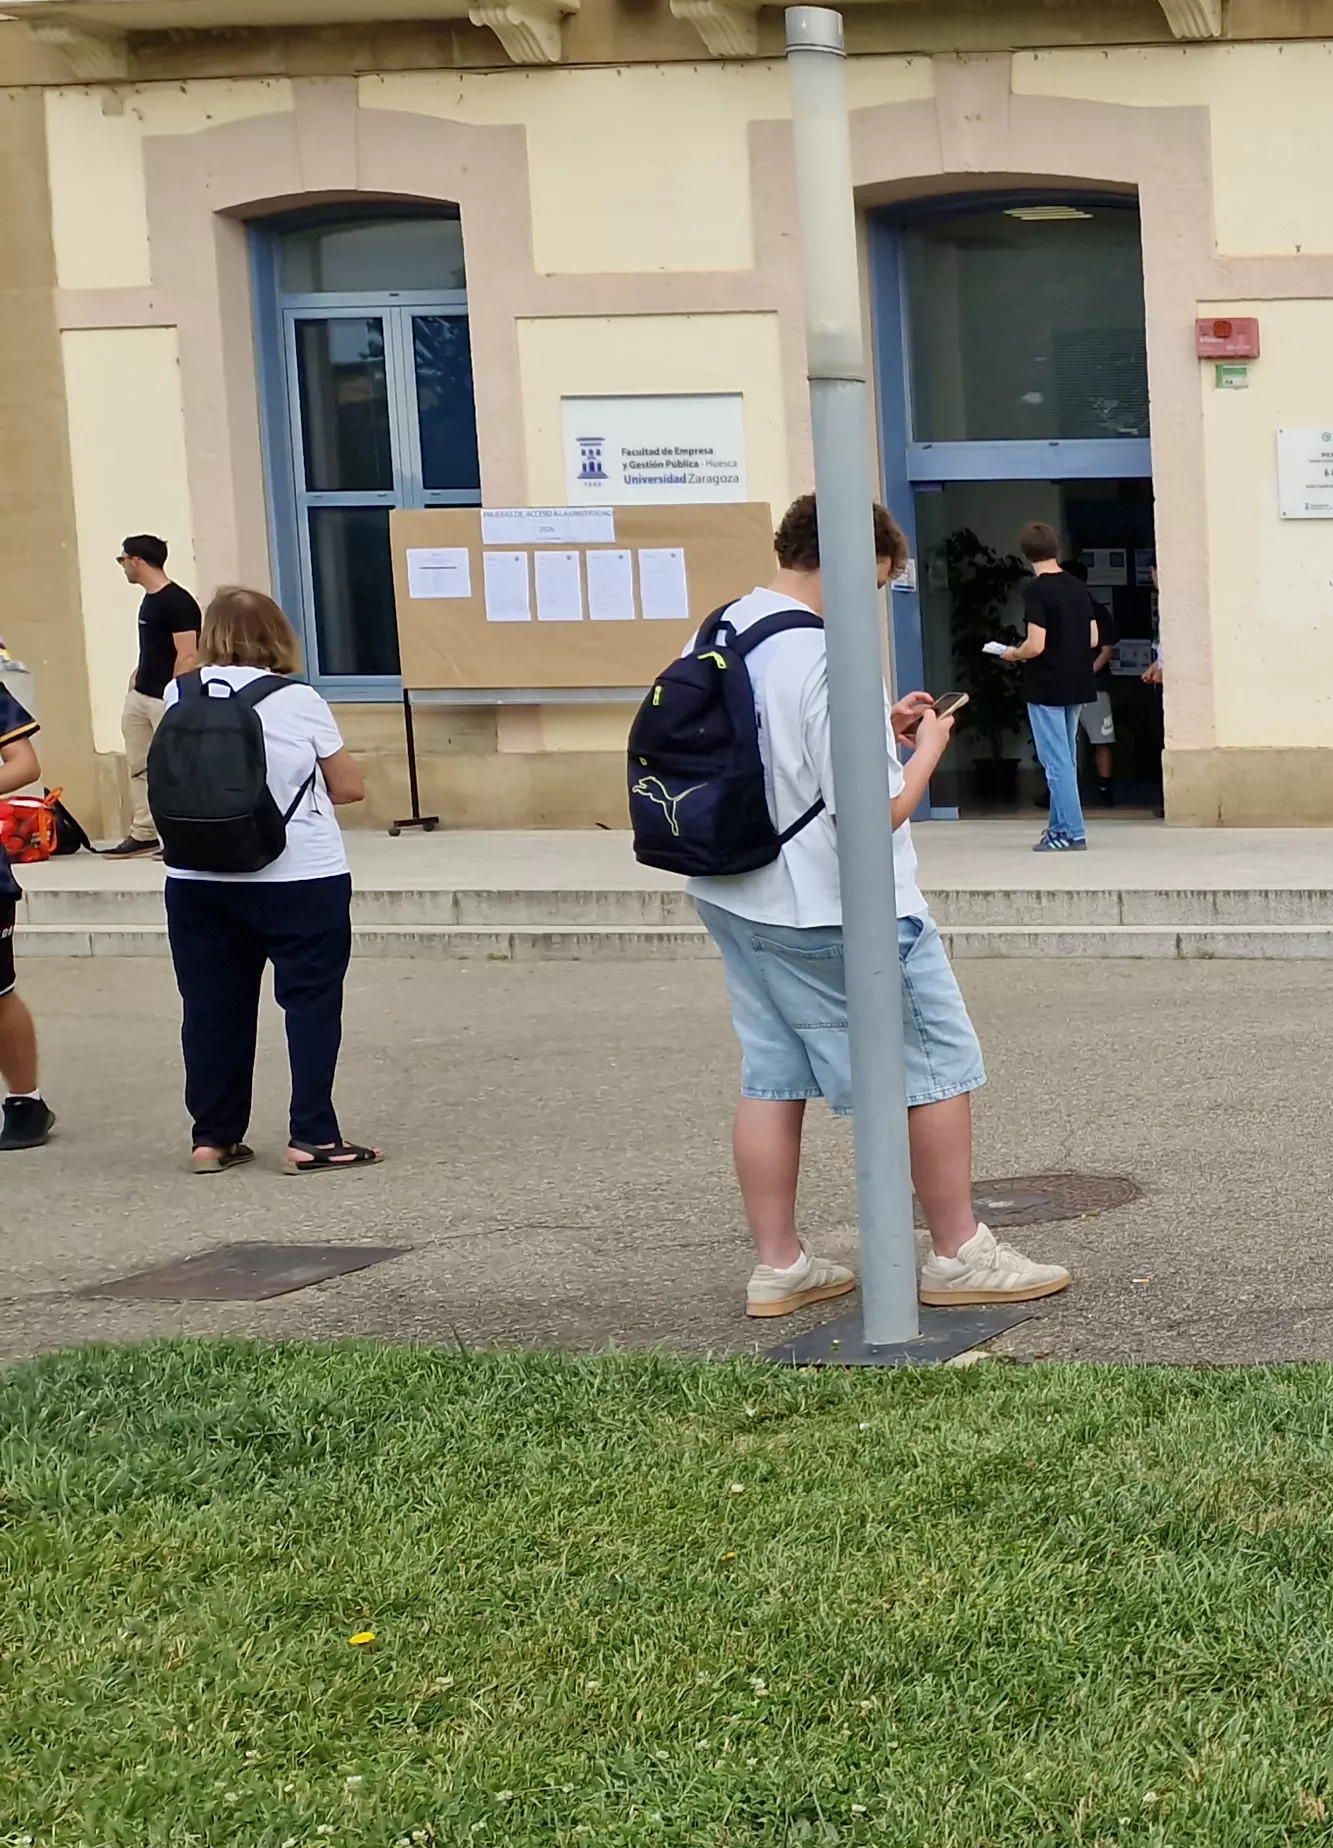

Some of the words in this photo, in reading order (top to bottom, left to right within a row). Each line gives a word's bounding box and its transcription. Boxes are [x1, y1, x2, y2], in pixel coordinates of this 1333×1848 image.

[621, 447, 661, 456] Facultad
[661, 447, 673, 456] de
[674, 446, 713, 457] Empresa
[622, 462, 628, 471] y
[629, 460, 665, 469] Gestión
[666, 460, 699, 468] Pública
[706, 460, 738, 468] Huesca
[624, 472, 687, 484] Universidad
[688, 473, 739, 486] Zaragoza
[527, 510, 552, 518] ACCESO
